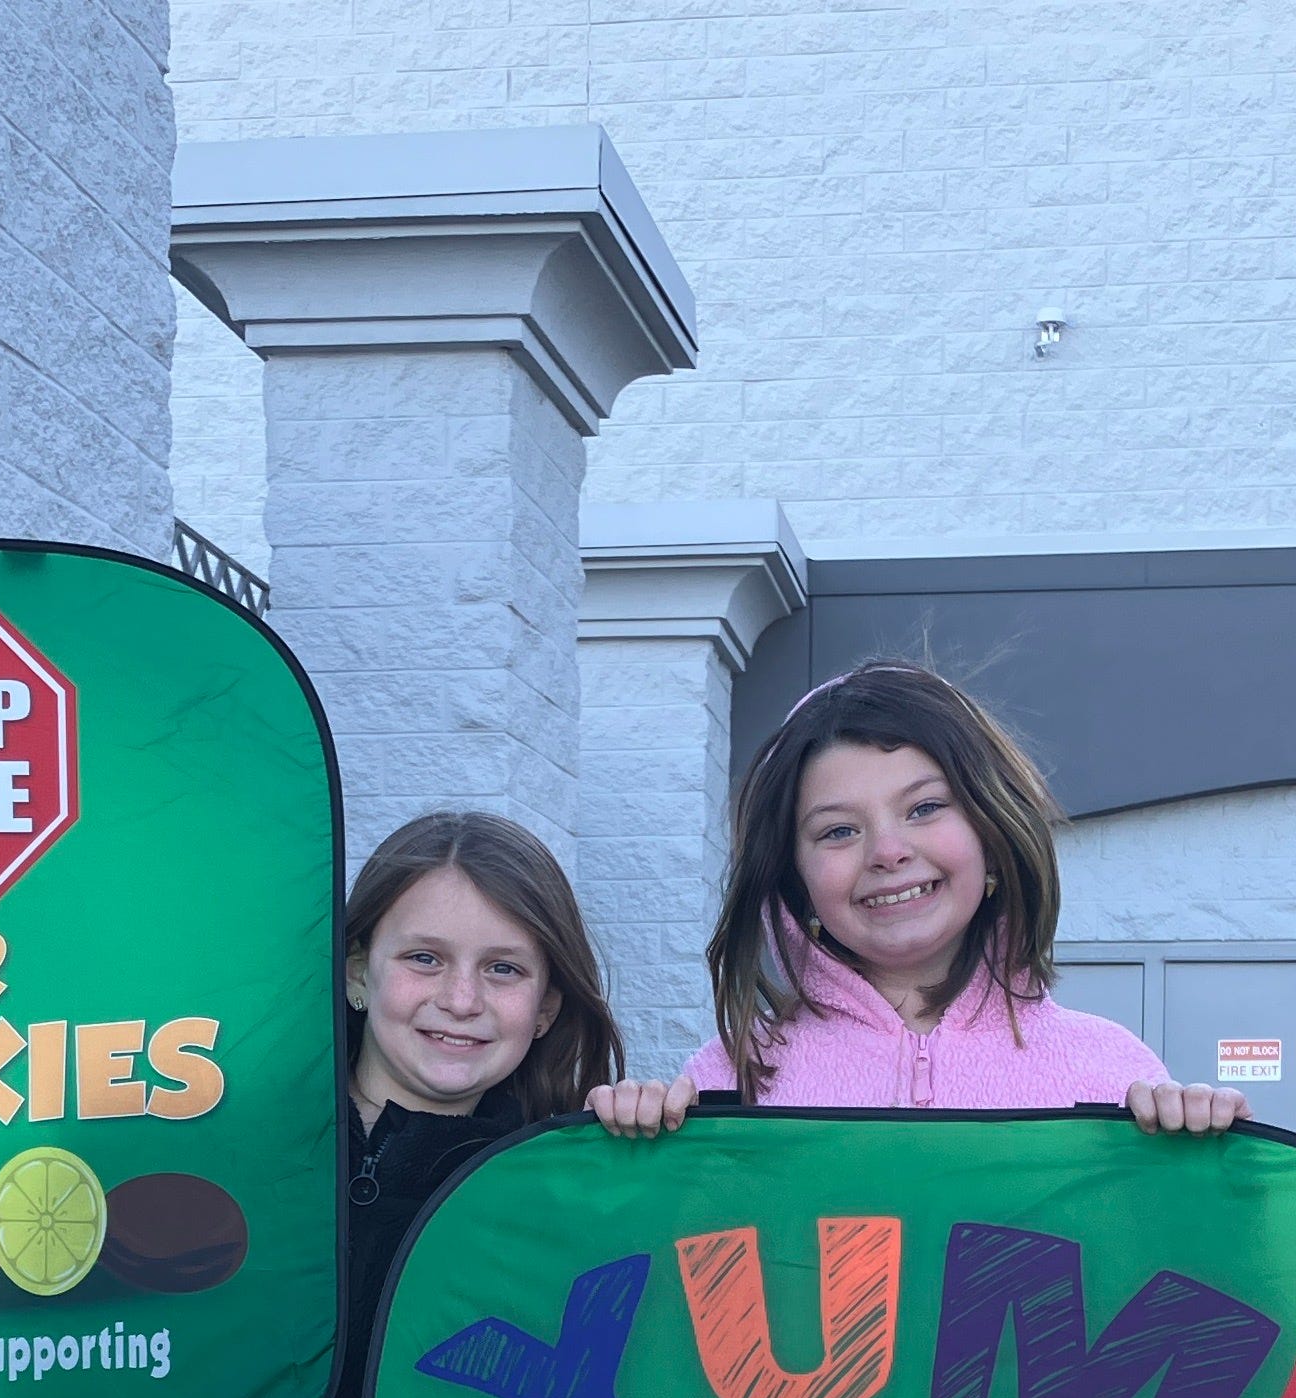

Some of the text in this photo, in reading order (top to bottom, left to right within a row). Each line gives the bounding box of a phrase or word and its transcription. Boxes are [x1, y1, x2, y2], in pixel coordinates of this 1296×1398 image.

[1220, 1046, 1279, 1056] DO NOT BLOCK
[1219, 1065, 1279, 1076] FIRE EXIT
